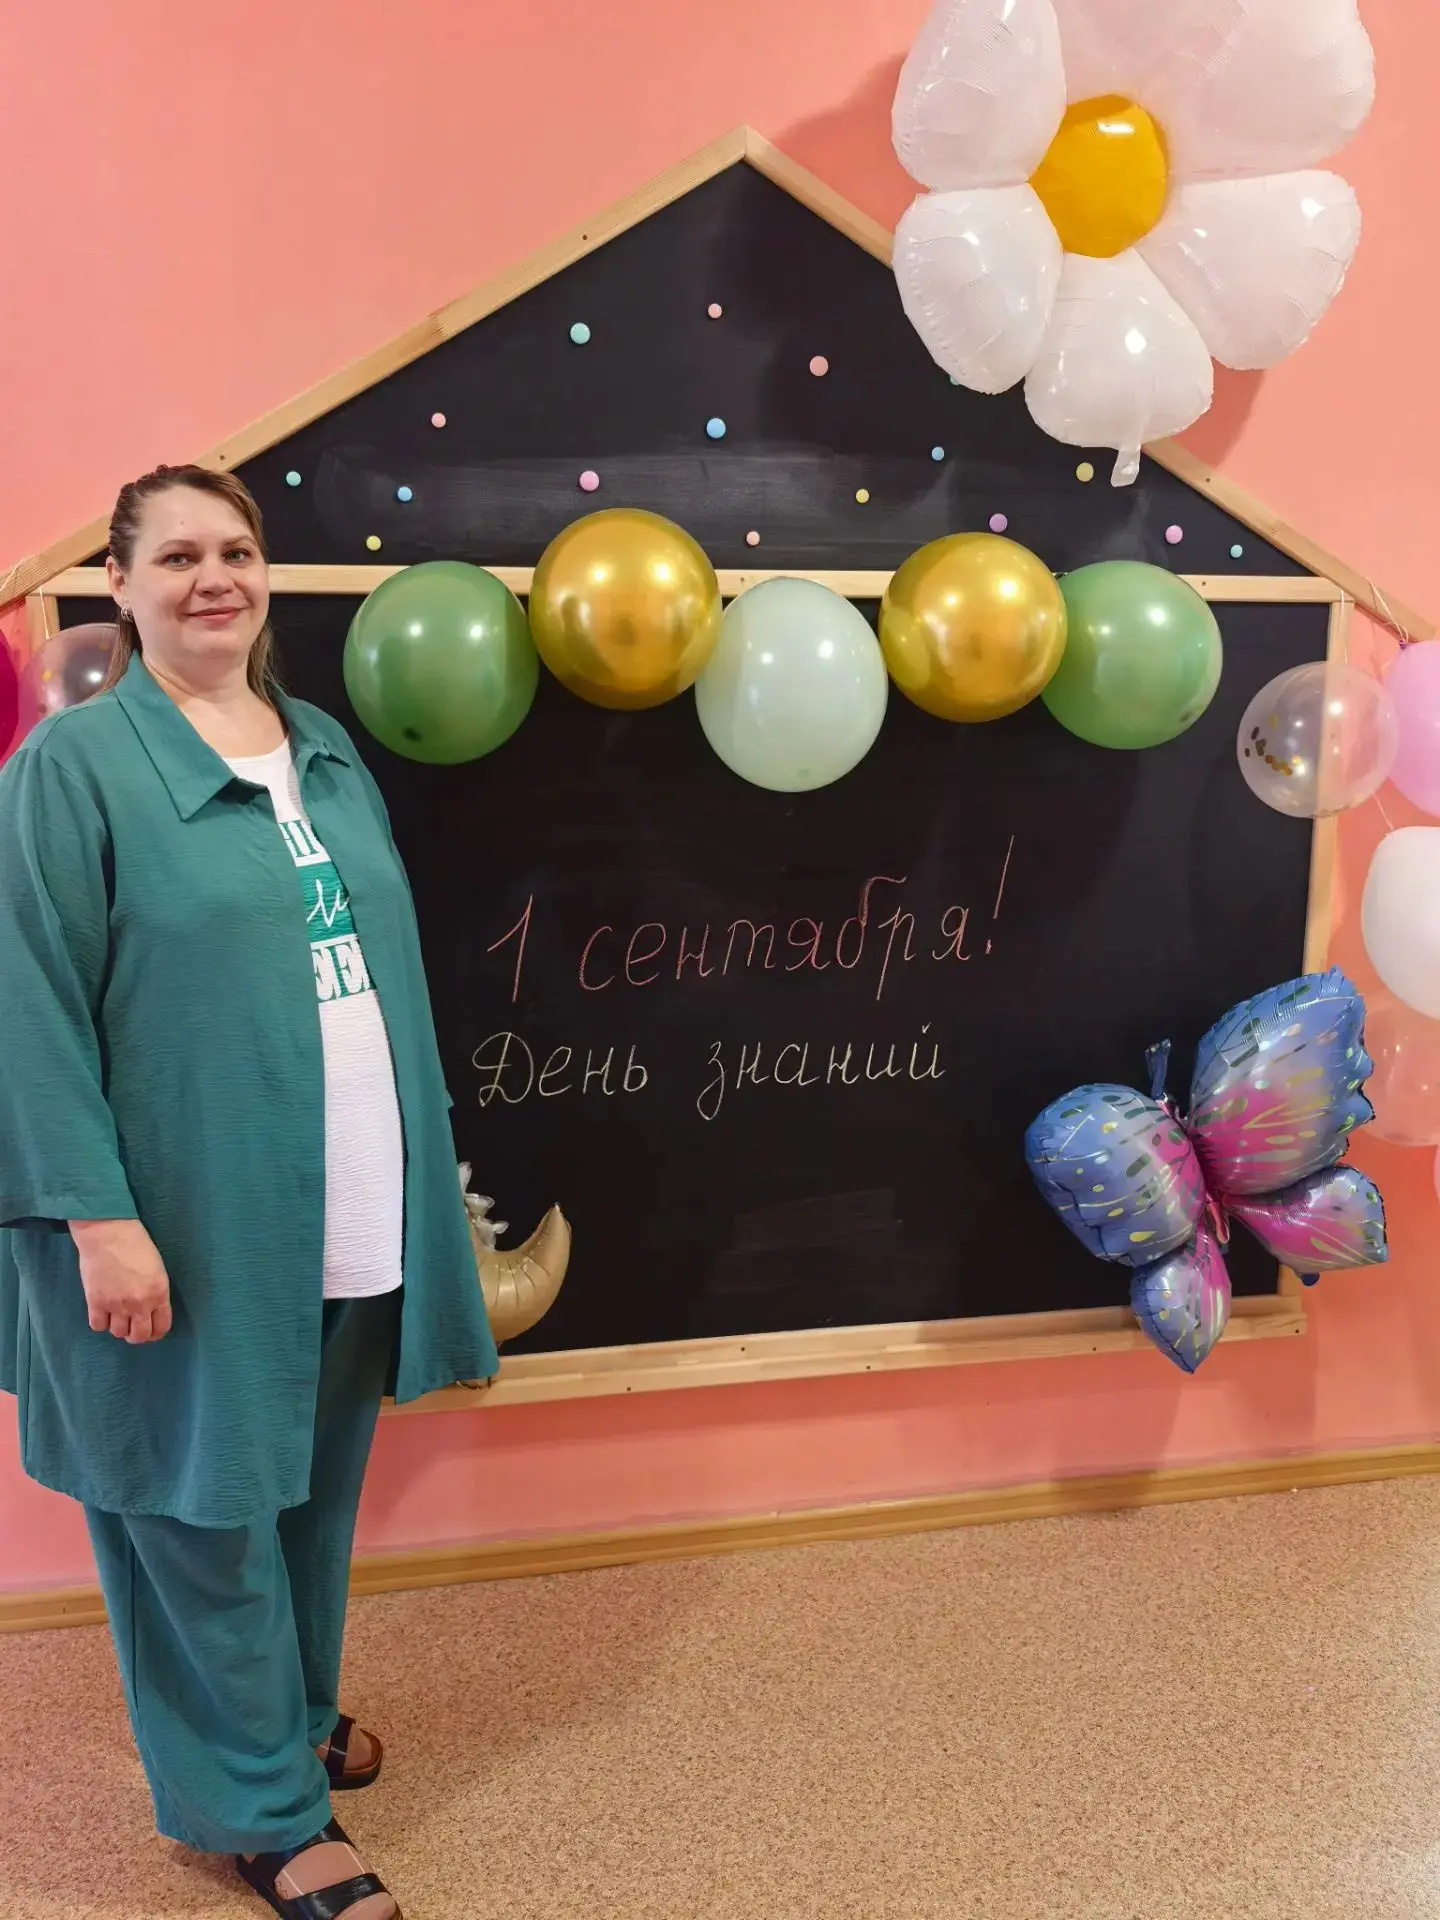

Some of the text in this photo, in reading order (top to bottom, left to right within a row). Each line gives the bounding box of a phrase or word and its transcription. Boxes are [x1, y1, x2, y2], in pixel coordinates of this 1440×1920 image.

[487, 834, 1014, 1002] 1 сентября!
[471, 1022, 946, 1120] День знаний
